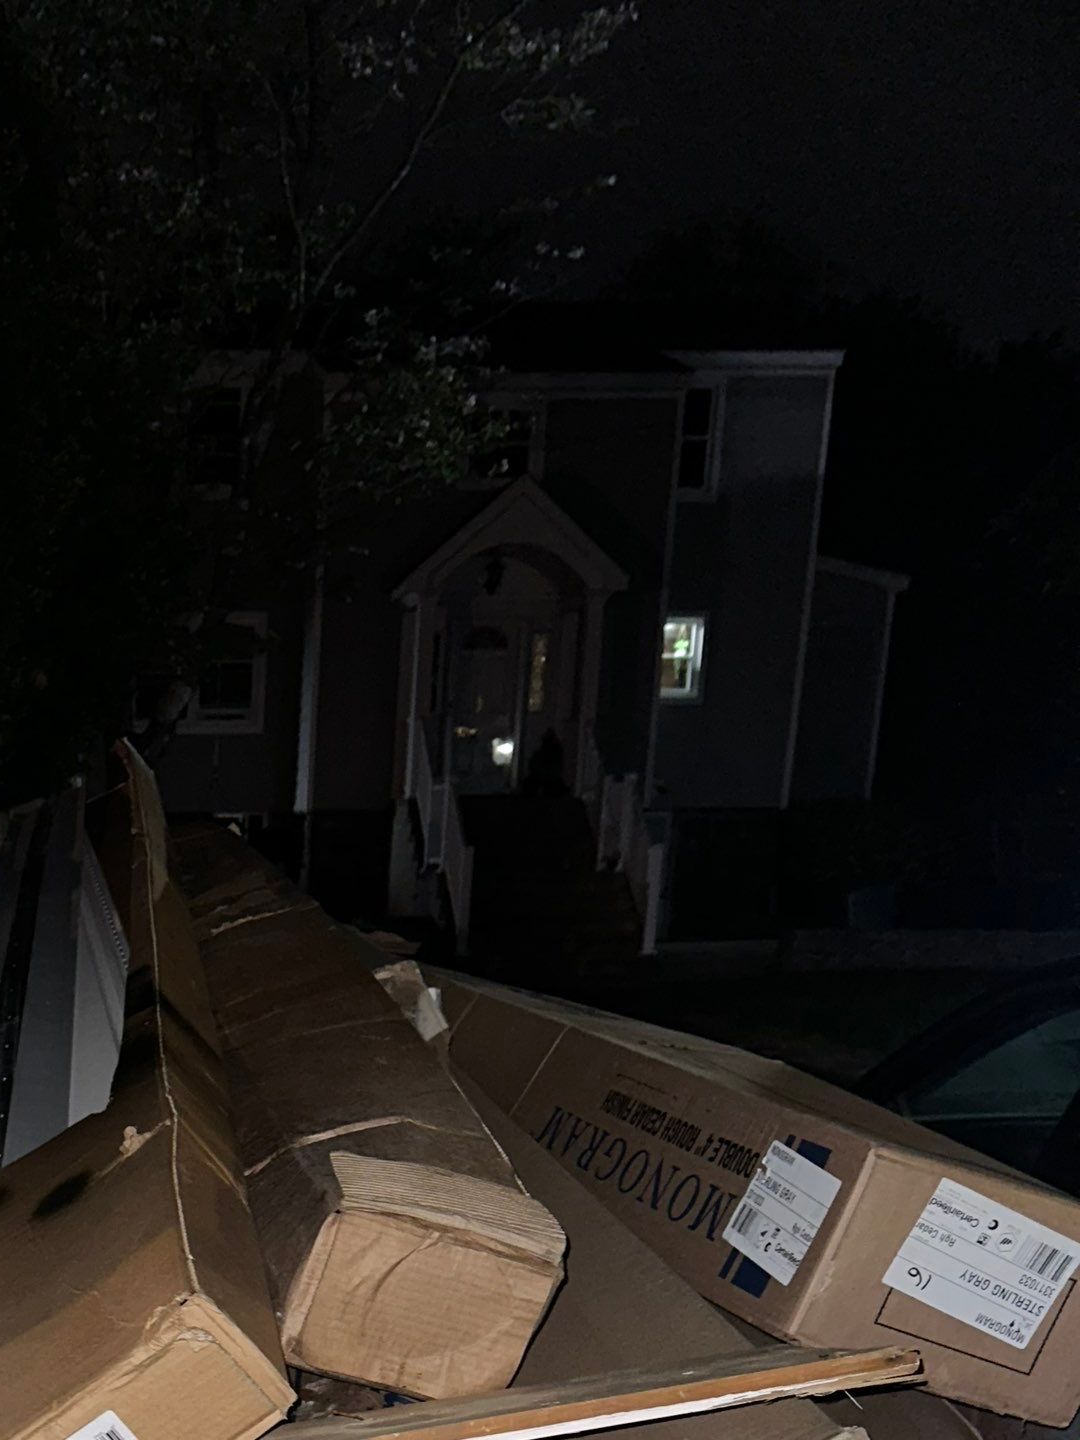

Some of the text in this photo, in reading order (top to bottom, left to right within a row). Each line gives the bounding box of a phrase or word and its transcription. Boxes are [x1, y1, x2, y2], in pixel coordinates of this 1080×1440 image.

[599, 1089, 638, 1122] FINISH
[629, 1100, 668, 1137] CEDAR
[658, 1116, 702, 1153] ROUGH
[535, 1105, 738, 1242] MONOGRAM
[713, 1136, 761, 1179] DOUBLE
[928, 1197, 980, 1229] CertainTeed
[916, 1221, 957, 1248] Rgh Cedar
[907, 1266, 933, 1291] 16
[959, 1268, 1045, 1318] STERLING GRAY
[1018, 1273, 1056, 1299] 3311033
[974, 1312, 1026, 1345] MONOGRAM
